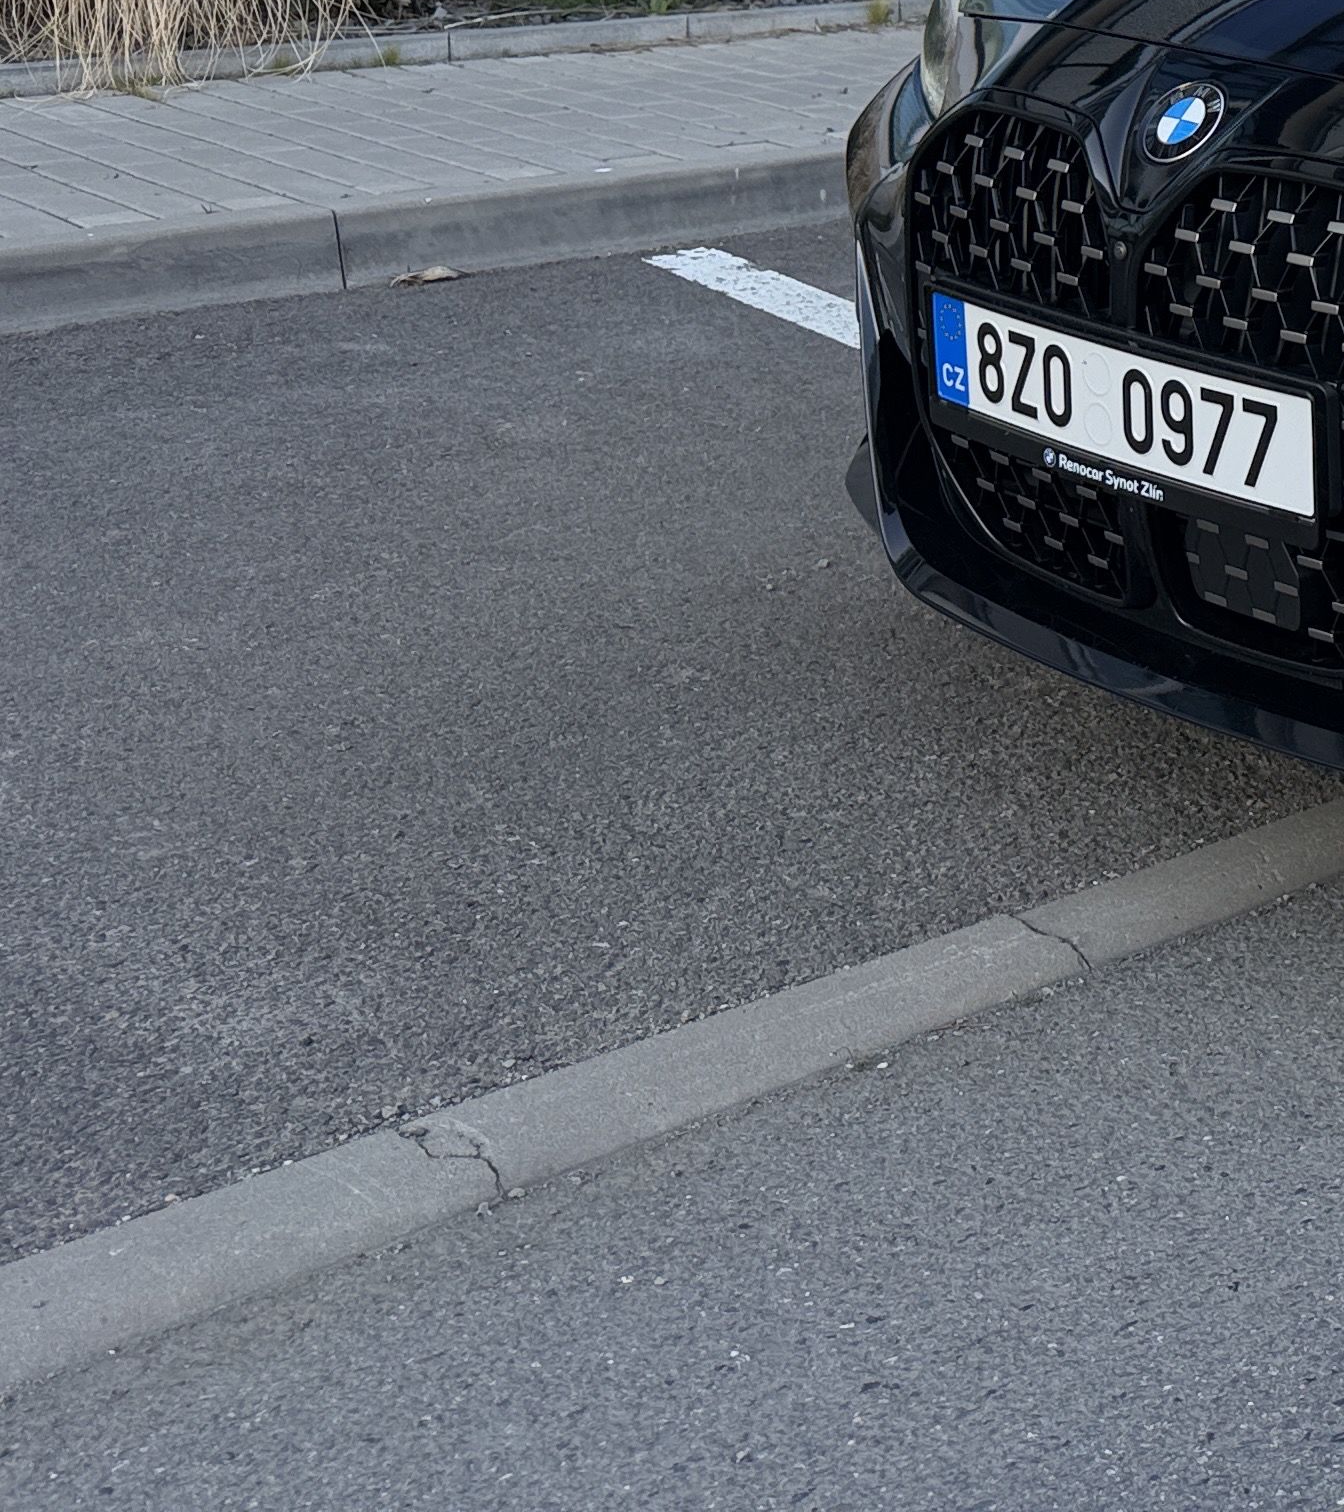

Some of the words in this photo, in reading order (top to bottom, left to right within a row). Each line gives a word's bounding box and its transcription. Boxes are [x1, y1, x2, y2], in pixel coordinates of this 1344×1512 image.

[942, 363, 966, 392] CZ
[1121, 368, 1279, 488] 0977
[1058, 453, 1105, 483] Renocar
[1104, 469, 1140, 495] Synot
[1140, 480, 1165, 502] Zlín
